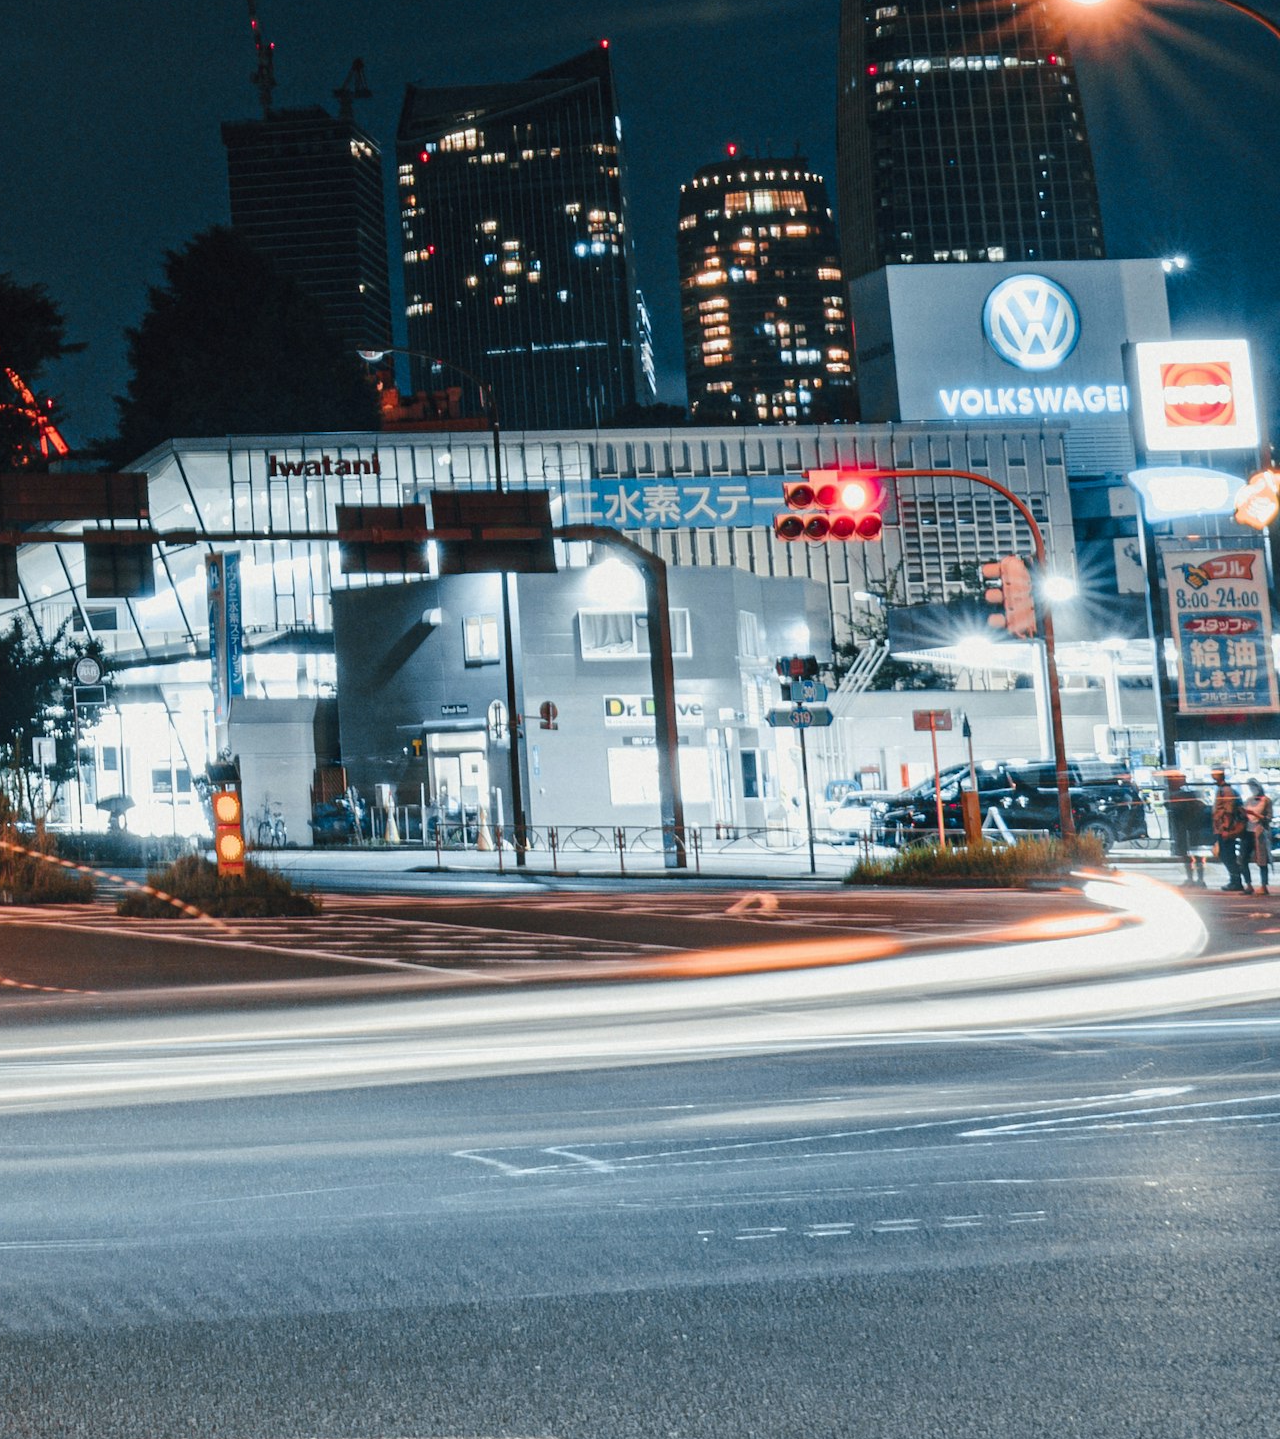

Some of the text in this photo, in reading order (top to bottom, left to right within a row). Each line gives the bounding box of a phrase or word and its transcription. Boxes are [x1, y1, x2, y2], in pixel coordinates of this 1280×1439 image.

[269, 452, 380, 477] Iwatani
[1211, 562, 1244, 576] フル
[1193, 619, 1252, 633] スタッフが
[1191, 639, 1257, 667] 給油
[1201, 692, 1255, 702] フルサービス
[605, 698, 637, 717] Dr.
[792, 710, 811, 723] 319
